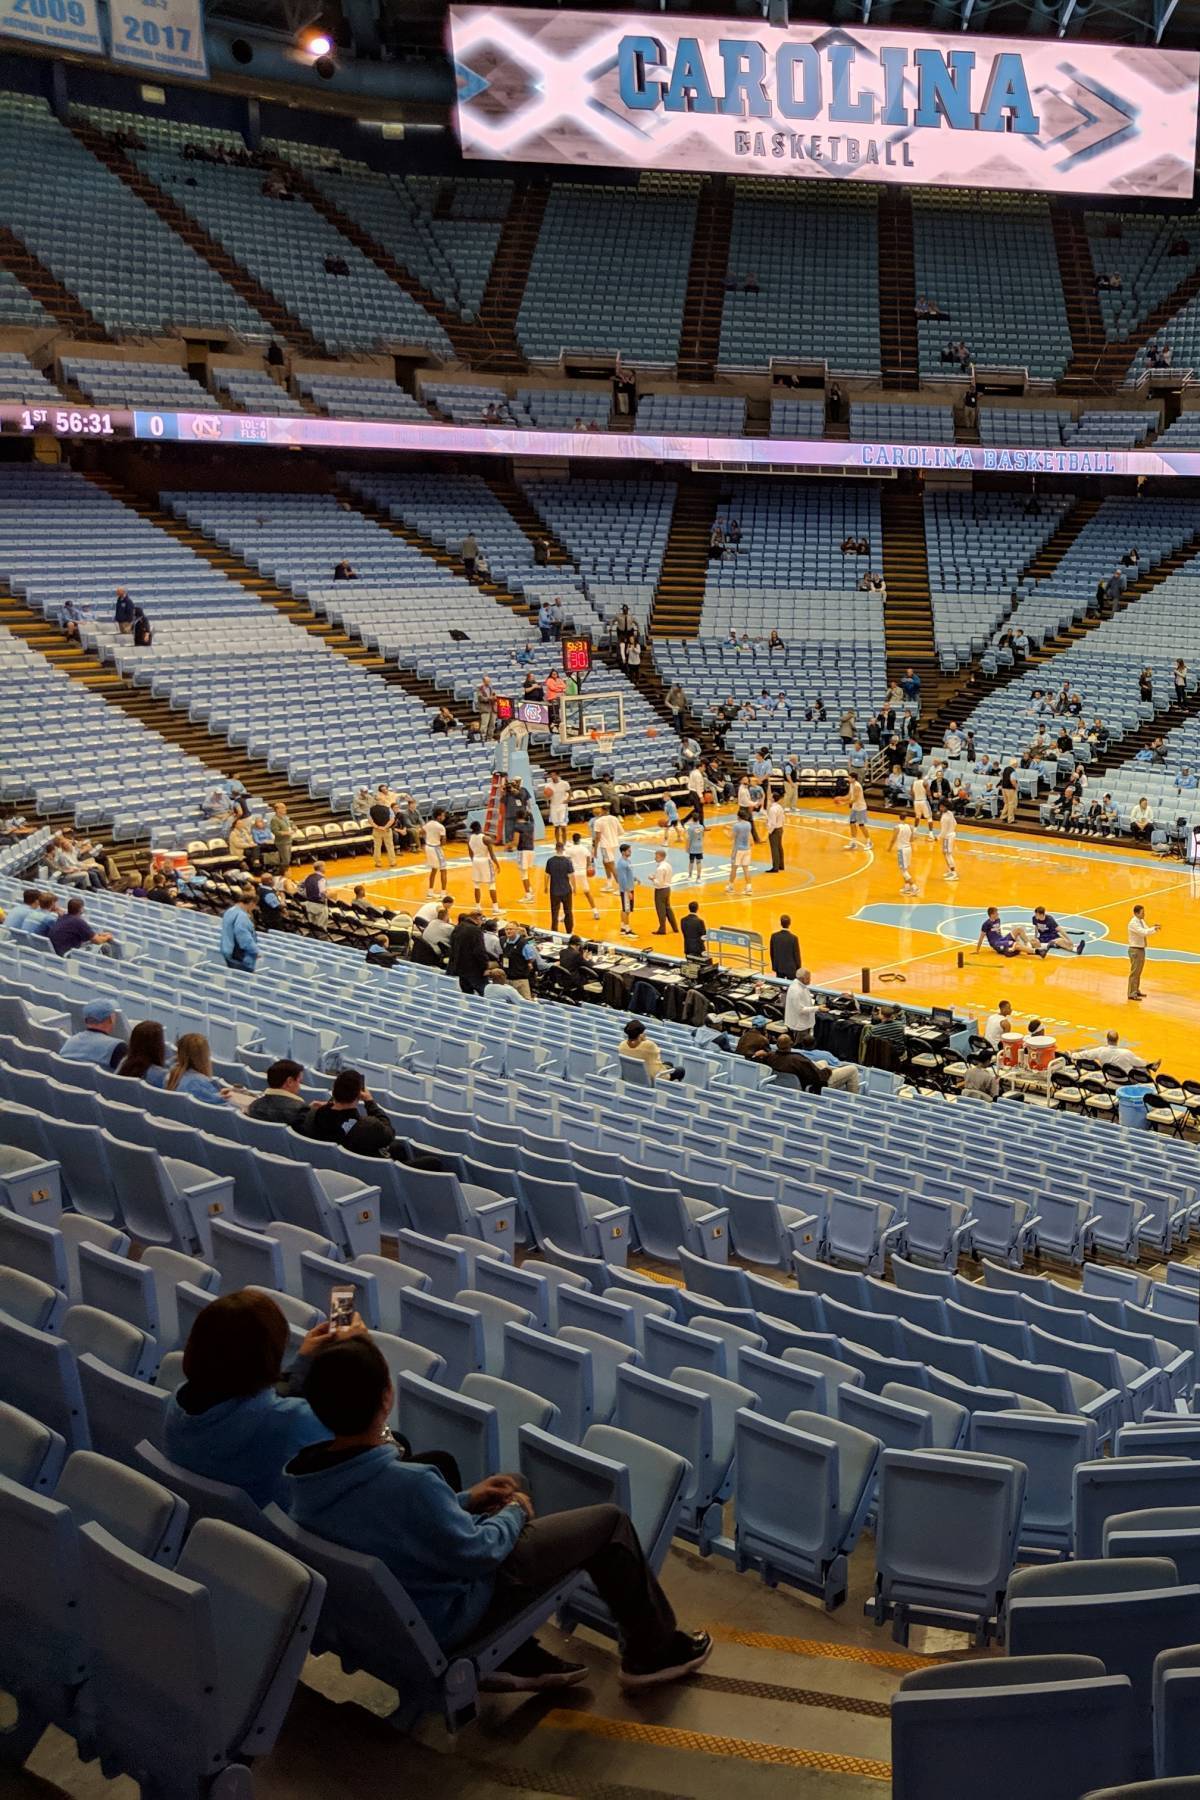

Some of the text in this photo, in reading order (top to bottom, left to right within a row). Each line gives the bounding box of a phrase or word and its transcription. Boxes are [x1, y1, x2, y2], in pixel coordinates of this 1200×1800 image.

[123, 16, 192, 52] 2017
[617, 35, 1040, 135] CAROLINA
[733, 130, 916, 167] BASKETBALL
[22, 410, 164, 436] 1ST 56:31 0
[861, 445, 1116, 473] CAROLINA BASKETBALL
[571, 652, 586, 668] 30
